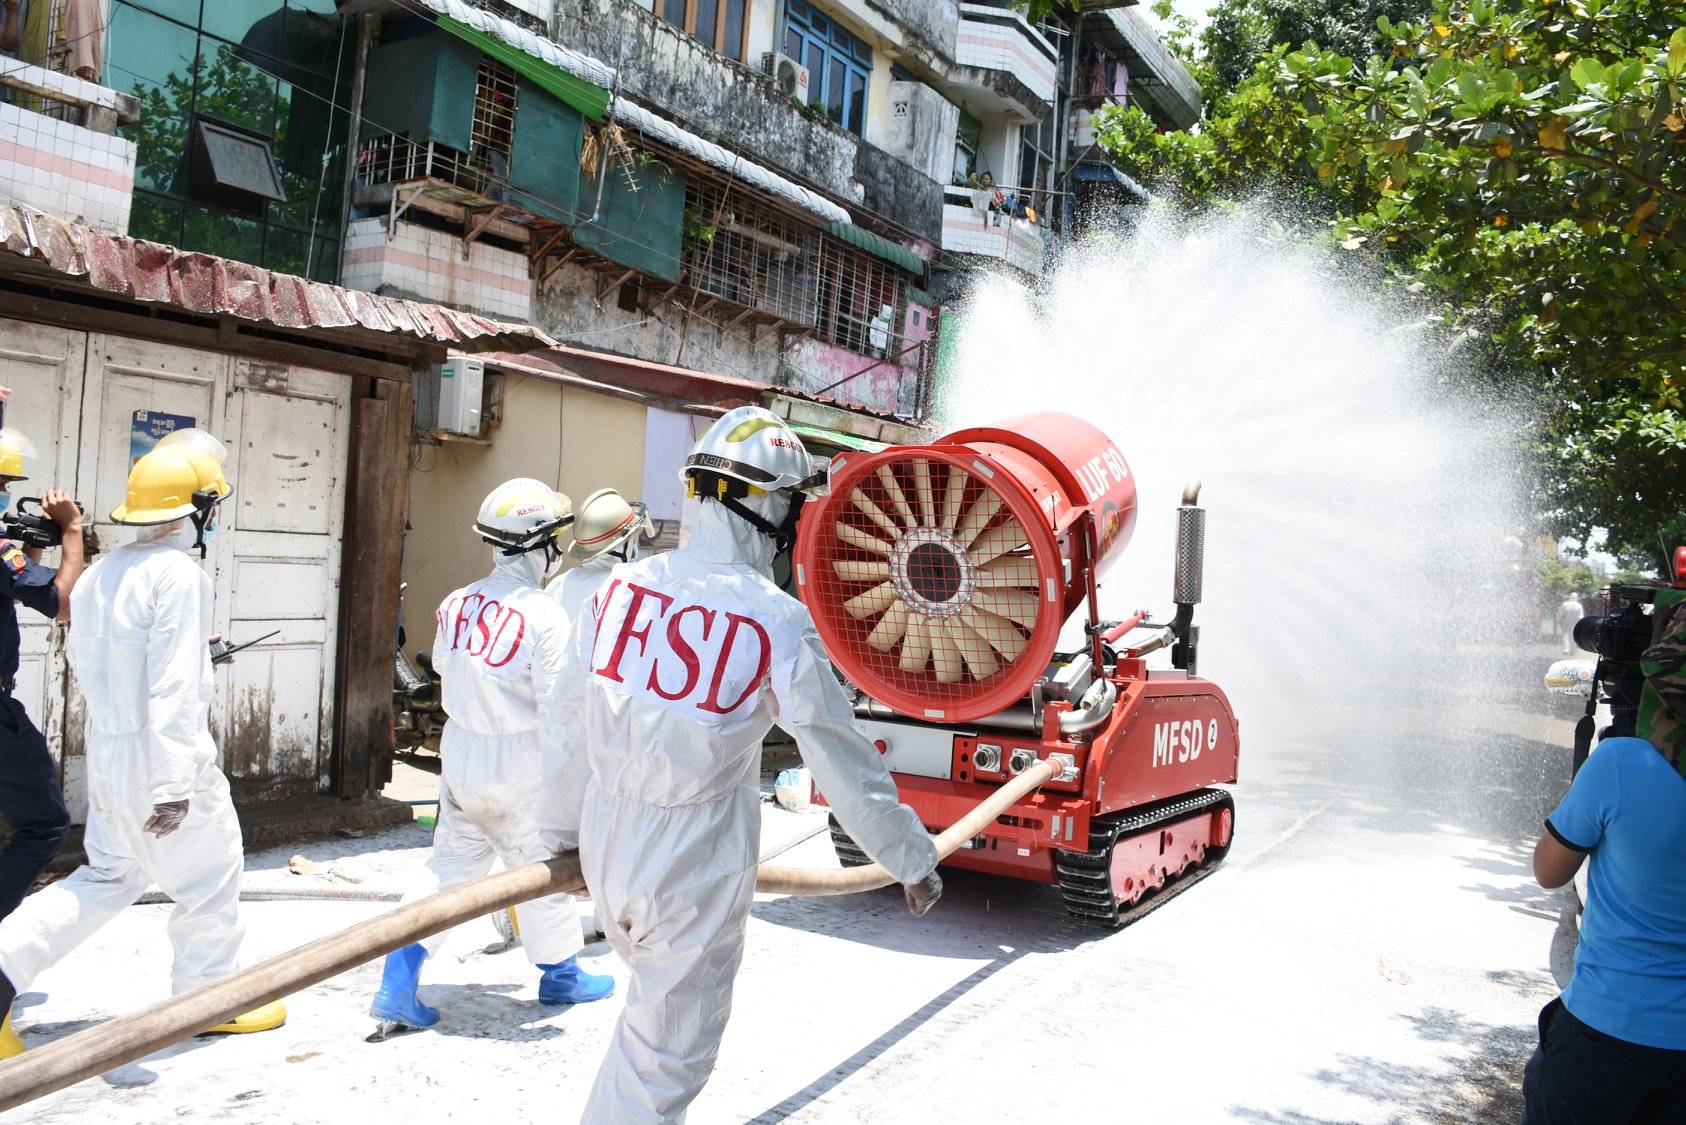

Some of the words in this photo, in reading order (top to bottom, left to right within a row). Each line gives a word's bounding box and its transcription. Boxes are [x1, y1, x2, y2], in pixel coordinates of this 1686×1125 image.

[1075, 456, 1111, 502] LUF
[1102, 447, 1128, 482] 60
[1152, 718, 1203, 768] MFSD
